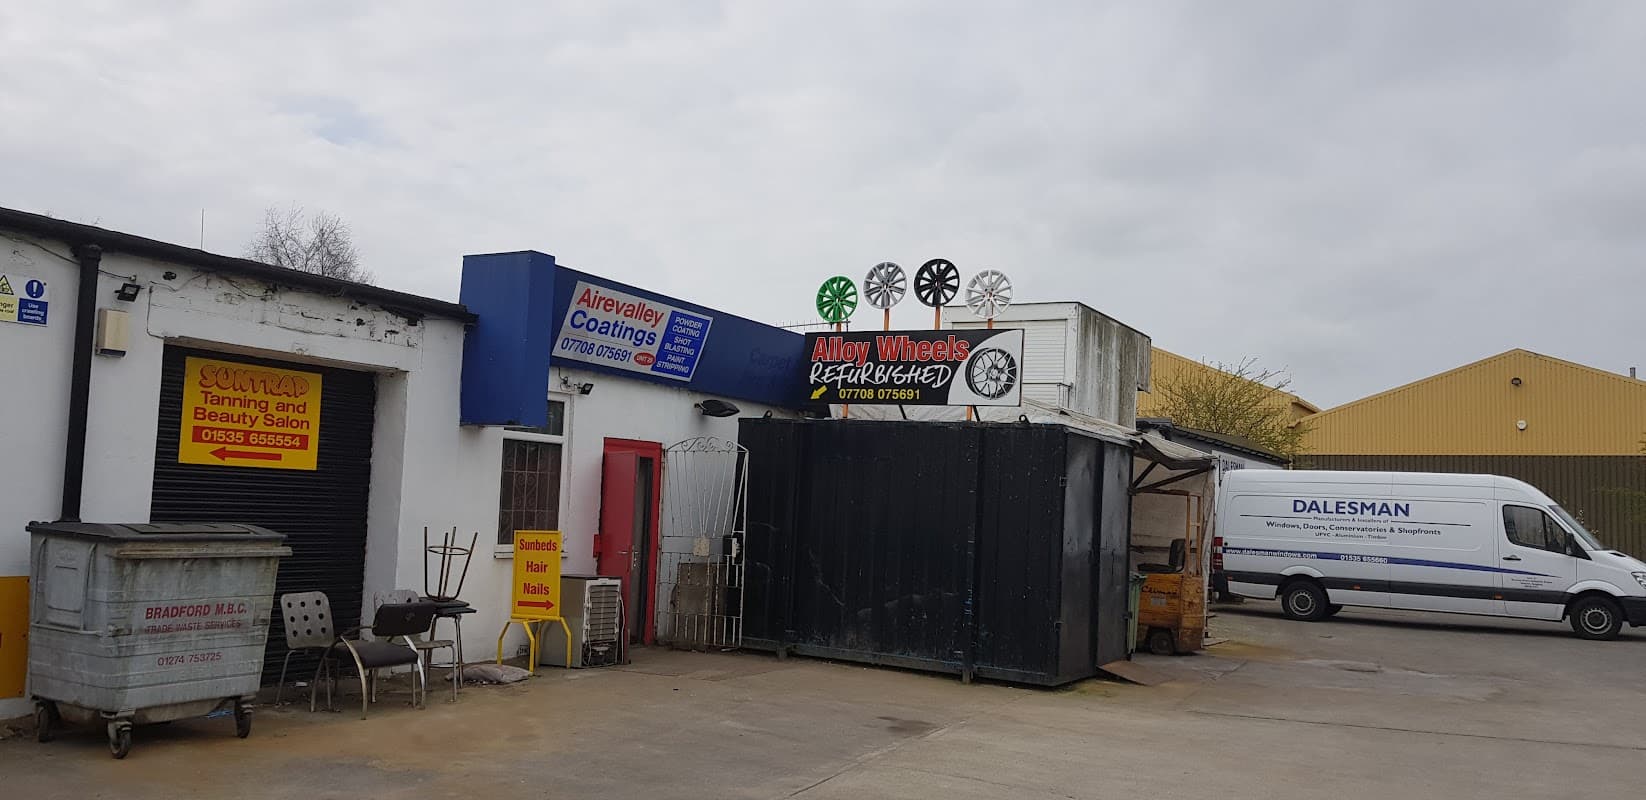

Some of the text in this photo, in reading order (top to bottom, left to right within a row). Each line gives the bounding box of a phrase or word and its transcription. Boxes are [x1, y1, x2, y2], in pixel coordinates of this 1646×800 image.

[577, 288, 664, 328] Airevalley
[570, 310, 657, 346] Coatings
[675, 317, 703, 329] POWDER
[672, 325, 700, 337] COATING
[674, 336, 692, 346] SHOT
[561, 338, 632, 362] 07708 075691
[664, 343, 695, 355] BLASTING
[812, 335, 970, 367] Alloy Wheels
[667, 354, 686, 364] PAINT
[656, 361, 690, 373] STRIPPING
[199, 365, 310, 398] SUNTRAP
[809, 362, 952, 389] REFURBISHED
[839, 388, 920, 400] 07708 075691
[200, 391, 307, 414] Tanning and
[193, 407, 310, 430] Beauty Salon
[201, 429, 301, 447] 01535 655554
[1293, 499, 1410, 517] DALESMAN
[1266, 521, 1301, 530] Windows,
[1303, 523, 1328, 531] Doors,
[1329, 524, 1387, 534] Conservatories
[1398, 527, 1441, 536] Shopfronts
[519, 538, 557, 551] Sunbeds
[1340, 554, 1361, 562] 01535
[526, 561, 548, 573] Hair
[523, 582, 550, 595] Nails
[145, 602, 247, 619] BRADFORD M.B.C.
[146, 619, 241, 634] TRADE WASTE SERVICES
[157, 651, 222, 666] 01274 753725
